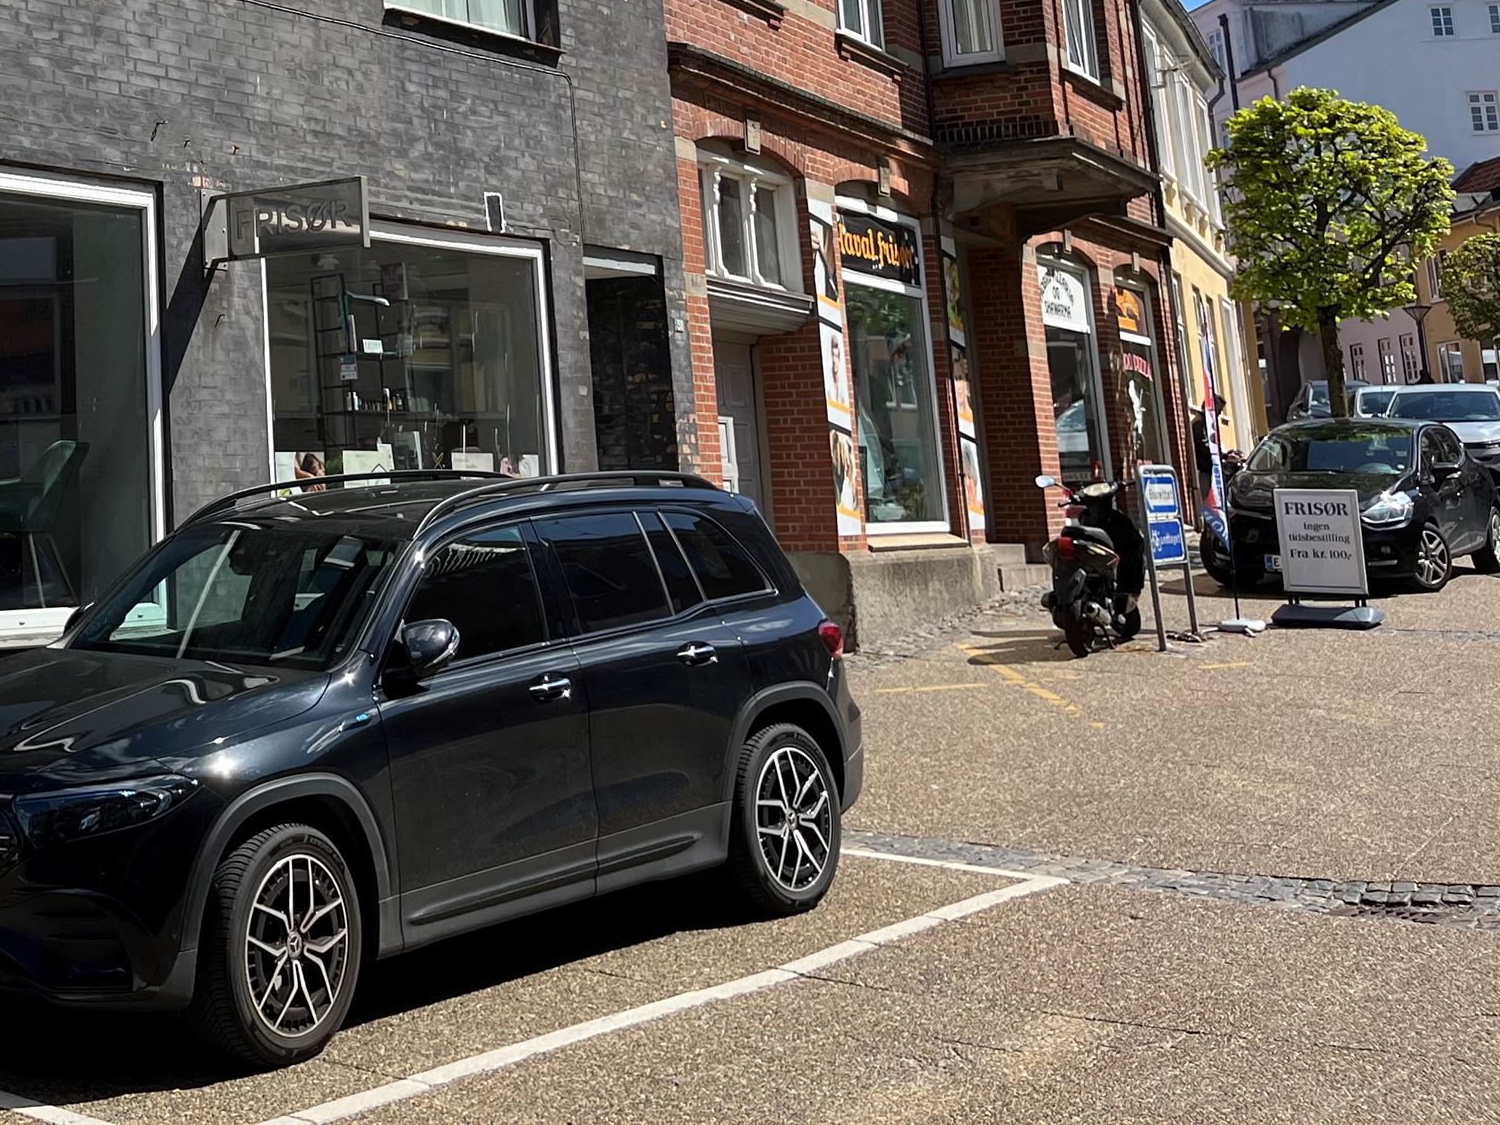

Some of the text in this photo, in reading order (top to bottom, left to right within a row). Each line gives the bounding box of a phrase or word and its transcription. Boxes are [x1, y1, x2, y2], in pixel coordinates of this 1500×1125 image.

[236, 198, 353, 240] FRISØR
[1284, 502, 1348, 516] FRISØR
[1288, 532, 1350, 544] tidsbestilling
[1290, 548, 1308, 559] Fra
[1312, 548, 1327, 559] kr.
